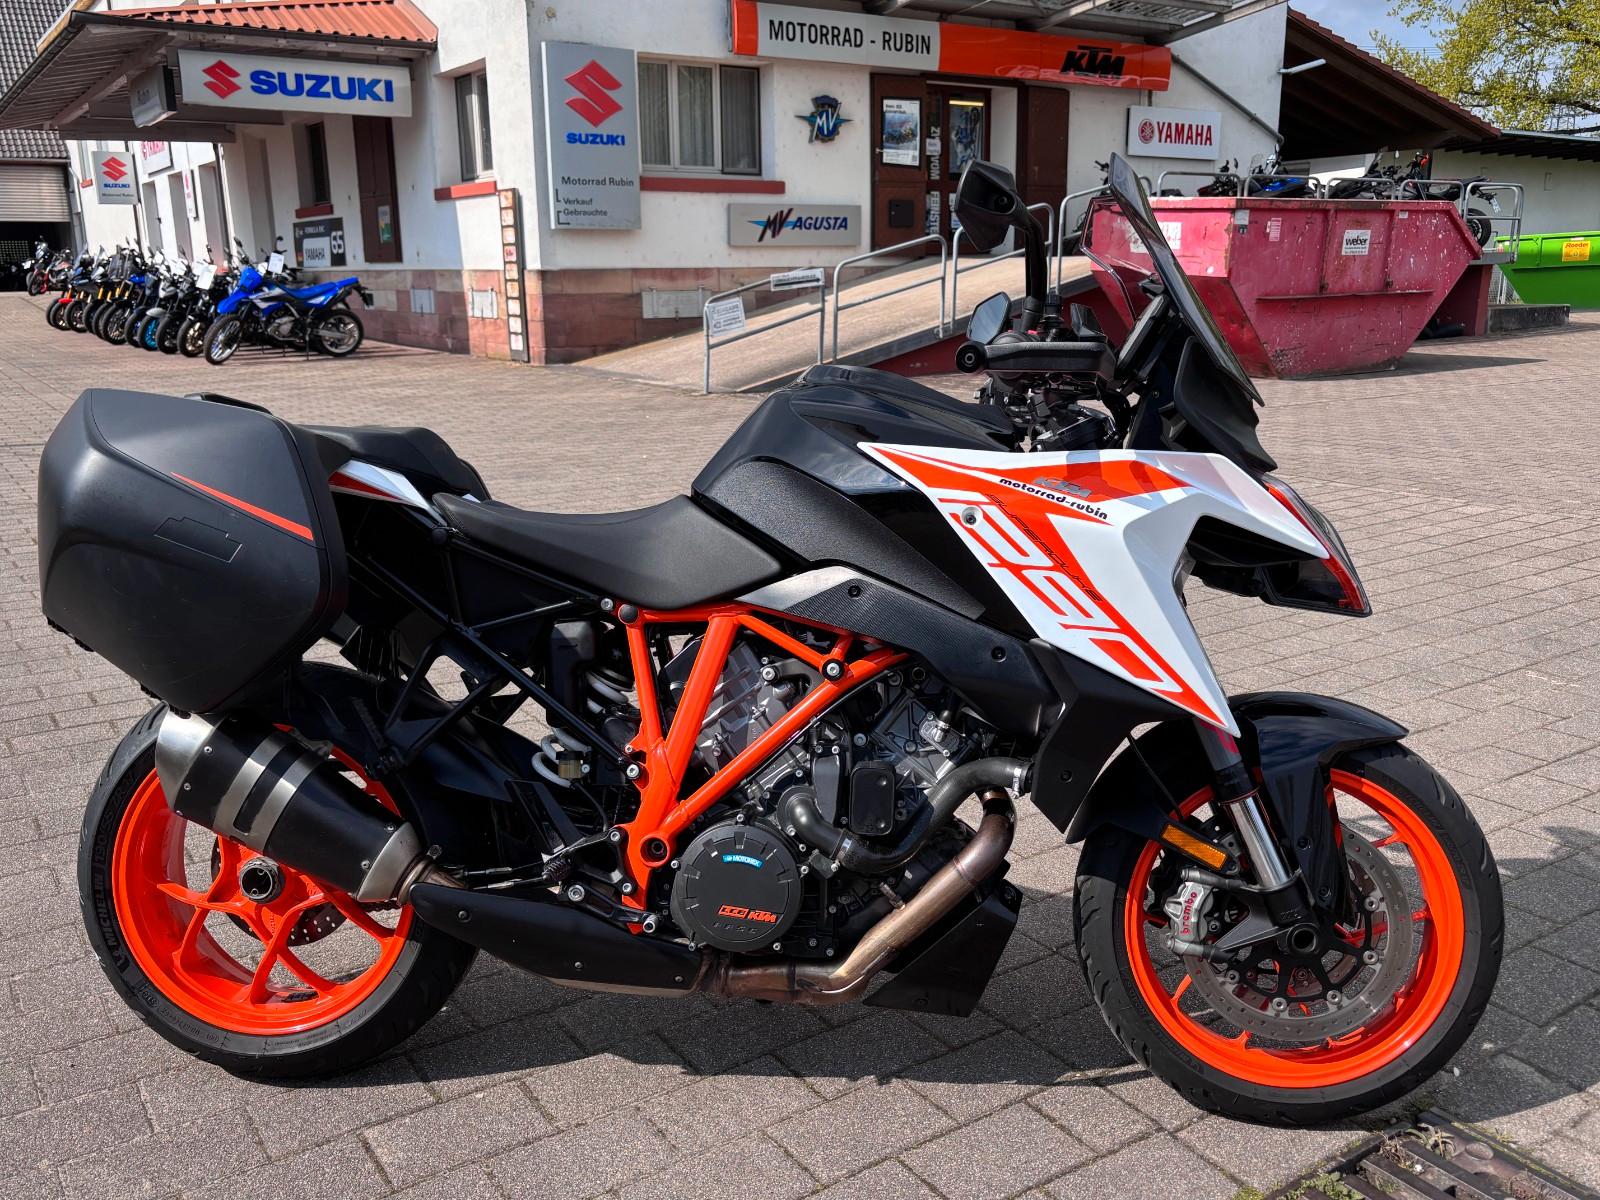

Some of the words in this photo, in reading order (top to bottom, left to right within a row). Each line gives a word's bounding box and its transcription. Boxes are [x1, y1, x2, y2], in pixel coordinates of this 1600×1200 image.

[769, 19, 863, 48] MOTORRAD
[882, 31, 931, 55] RUBIN
[1060, 45, 1125, 78] KTM
[250, 69, 394, 102] SUZUKI
[813, 102, 842, 141] MV
[1157, 121, 1213, 146] YAMAHA
[566, 132, 625, 146] SUZUKI
[561, 176, 607, 186] Motorrad
[609, 177, 634, 187] Rubin
[563, 198, 593, 206] Verkauf
[563, 208, 608, 217] Gebrauchte
[758, 207, 794, 242] MV
[791, 216, 848, 231] AGUSTA
[331, 231, 344, 255] 65
[1345, 235, 1368, 246] weber
[305, 247, 325, 261] YAMAHA
[1000, 478, 1108, 520] motorrad-rubin
[732, 855, 761, 868] MOTOREX
[94, 873, 119, 946] MICHELIN
[748, 910, 777, 922] KTM
[1181, 891, 1197, 935] brembo
